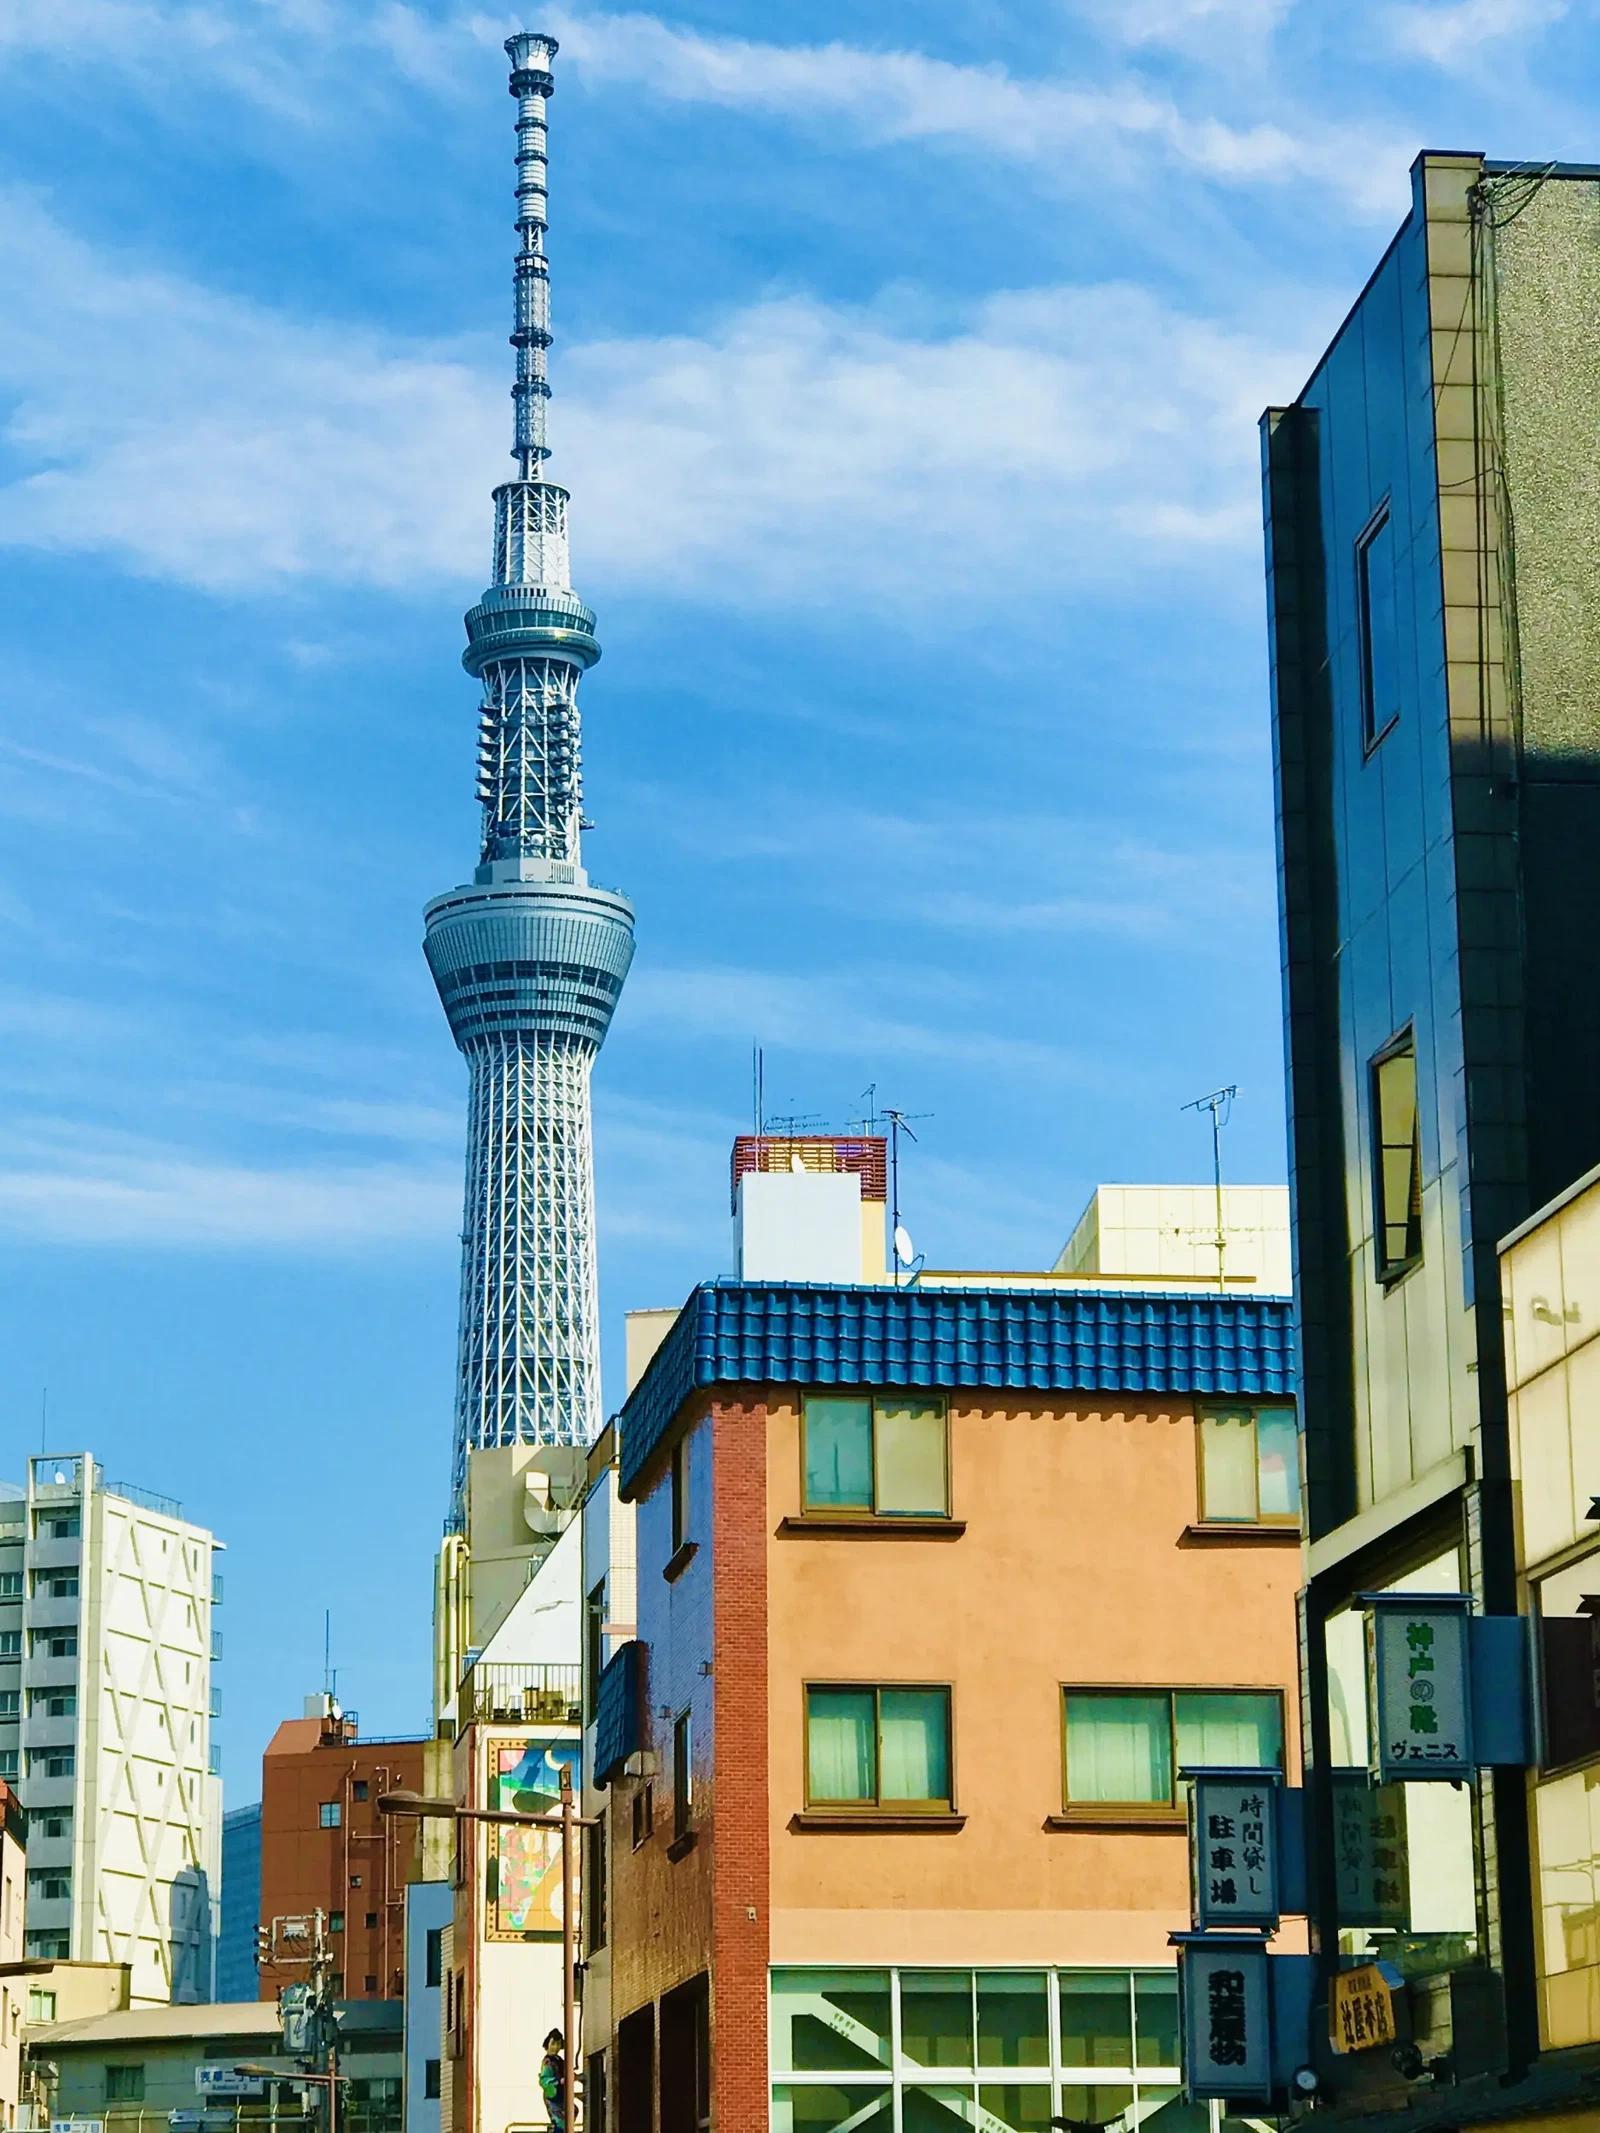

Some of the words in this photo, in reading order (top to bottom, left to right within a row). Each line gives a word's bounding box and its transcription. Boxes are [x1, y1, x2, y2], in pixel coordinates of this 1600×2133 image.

[1406, 1622, 1438, 1734] 神戸の靴
[1391, 1739, 1459, 1760] ヴェニス
[1208, 1815, 1237, 1904] 駐車場
[1240, 1794, 1265, 1895] 時間貸し
[1208, 1969, 1246, 2066] 和装履物
